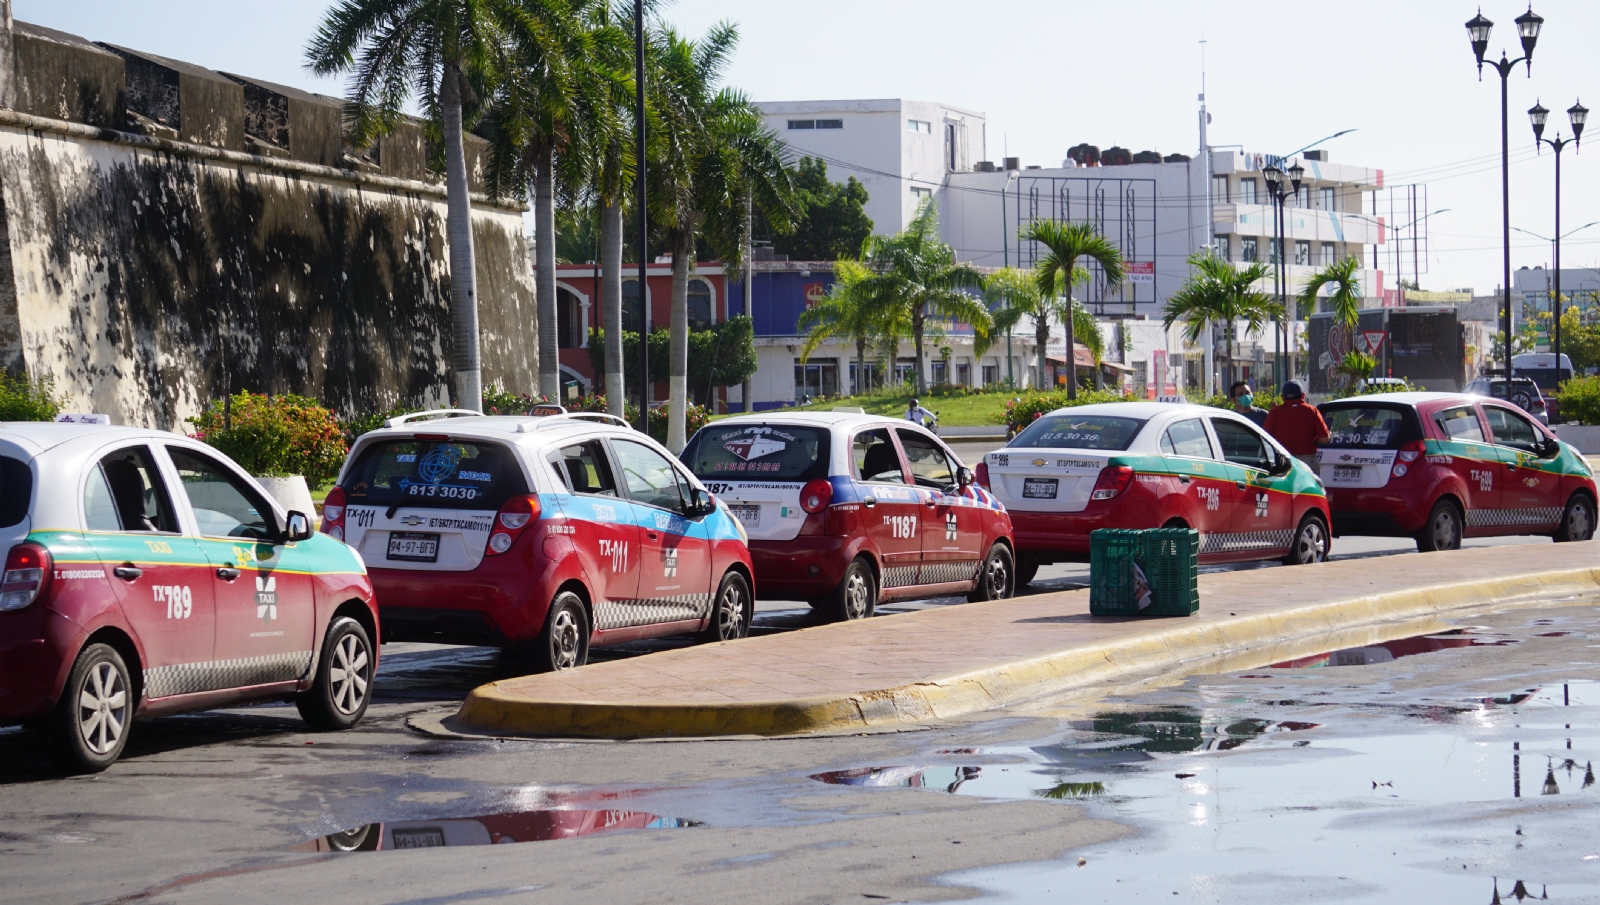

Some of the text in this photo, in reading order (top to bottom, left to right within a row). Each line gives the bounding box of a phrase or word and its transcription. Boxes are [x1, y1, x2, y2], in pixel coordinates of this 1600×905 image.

[458, 471, 491, 481] RADAR
[410, 486, 476, 500] 813 3030
[1197, 487, 1219, 510] TX-896
[347, 509, 376, 528] TX-011
[592, 504, 616, 521] TAXI
[654, 512, 684, 534] RADAR
[144, 541, 173, 553] TAXI
[390, 541, 435, 554] 94-97-BFB
[599, 540, 628, 573] TX-011
[666, 558, 676, 567] TAXI
[54, 571, 60, 579] T.
[259, 594, 275, 603] TAXI
